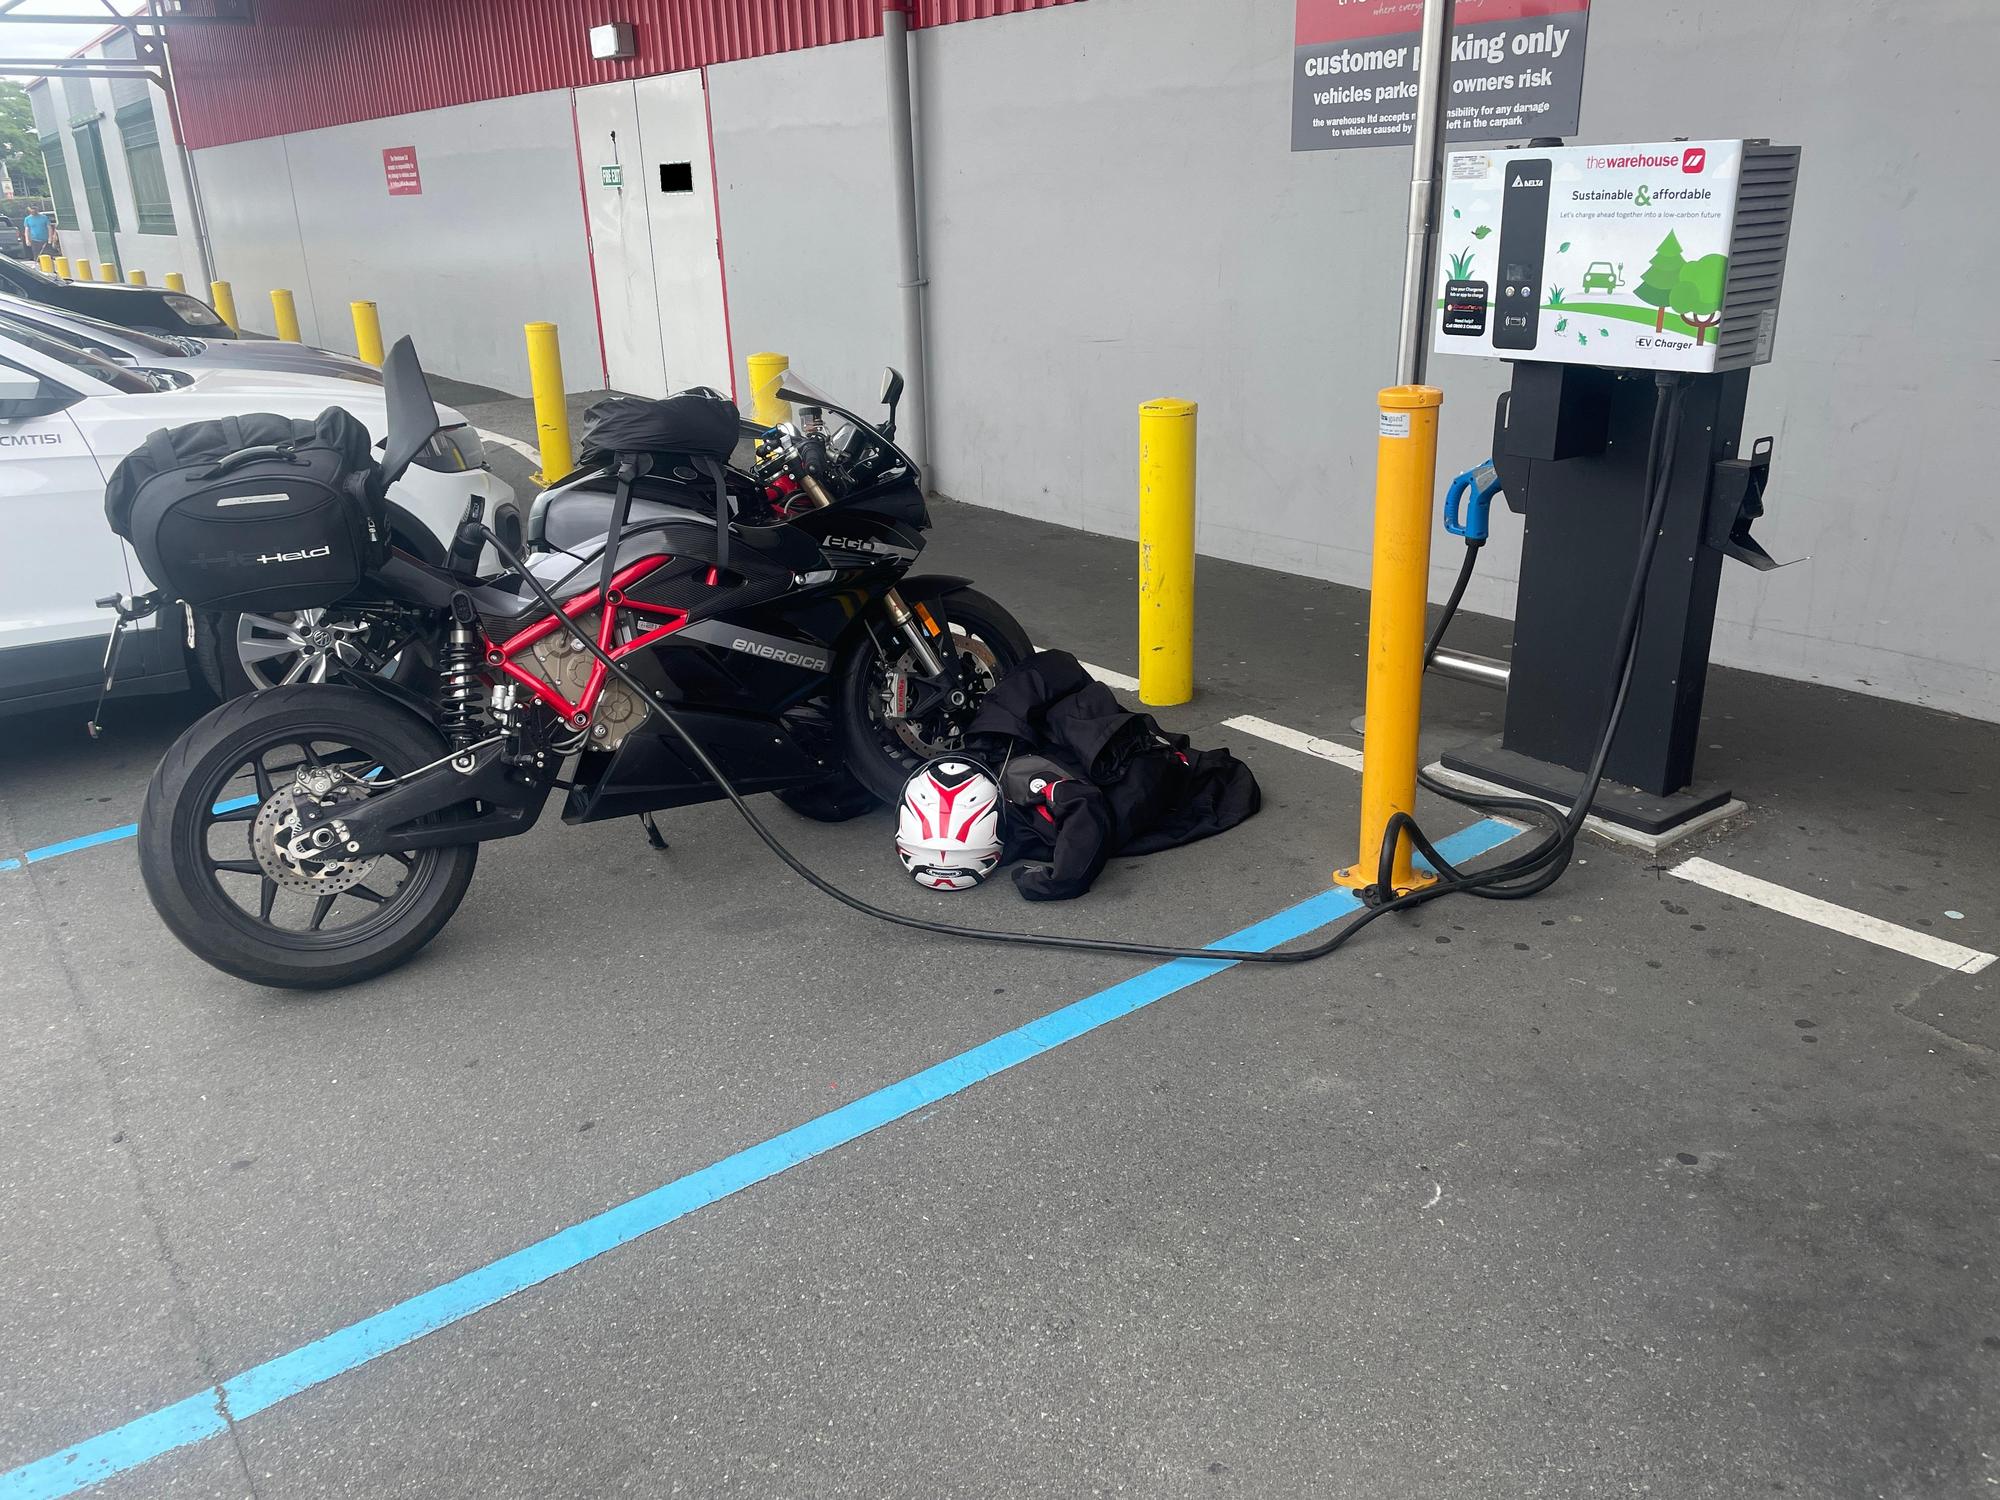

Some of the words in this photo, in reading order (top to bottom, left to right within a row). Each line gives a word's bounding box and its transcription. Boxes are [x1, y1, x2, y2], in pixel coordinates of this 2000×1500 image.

[1305, 48, 1408, 77] customer
[1412, 32, 1506, 72] king
[1511, 24, 1570, 58] only
[1313, 86, 1372, 105] vehicles
[1375, 81, 1419, 104] parke
[1452, 73, 1514, 94] owners
[1518, 67, 1553, 88] risk
[1312, 118, 1325, 127] the
[1326, 114, 1366, 126] warehouse
[1367, 114, 1378, 123] ltd
[1379, 111, 1410, 123] accepts
[1480, 105, 1494, 116] for
[1495, 104, 1512, 117] any
[1513, 101, 1550, 113] damage
[1332, 128, 1340, 137] to
[1341, 126, 1372, 136] vehicles
[1373, 124, 1401, 134] caused
[1402, 123, 1413, 134] by
[1446, 119, 1462, 129] left
[1463, 119, 1471, 128] in
[1472, 118, 1487, 128] the
[1489, 116, 1523, 128] carpark
[1572, 189, 1633, 200] Sustainable
[1634, 184, 1652, 206] &
[1652, 188, 1712, 200] affordable
[1575, 211, 1596, 219] charge
[1616, 211, 1643, 219] together
[1638, 338, 1652, 347] EV
[1654, 339, 1693, 351] Charger
[256, 545, 331, 564] Held
